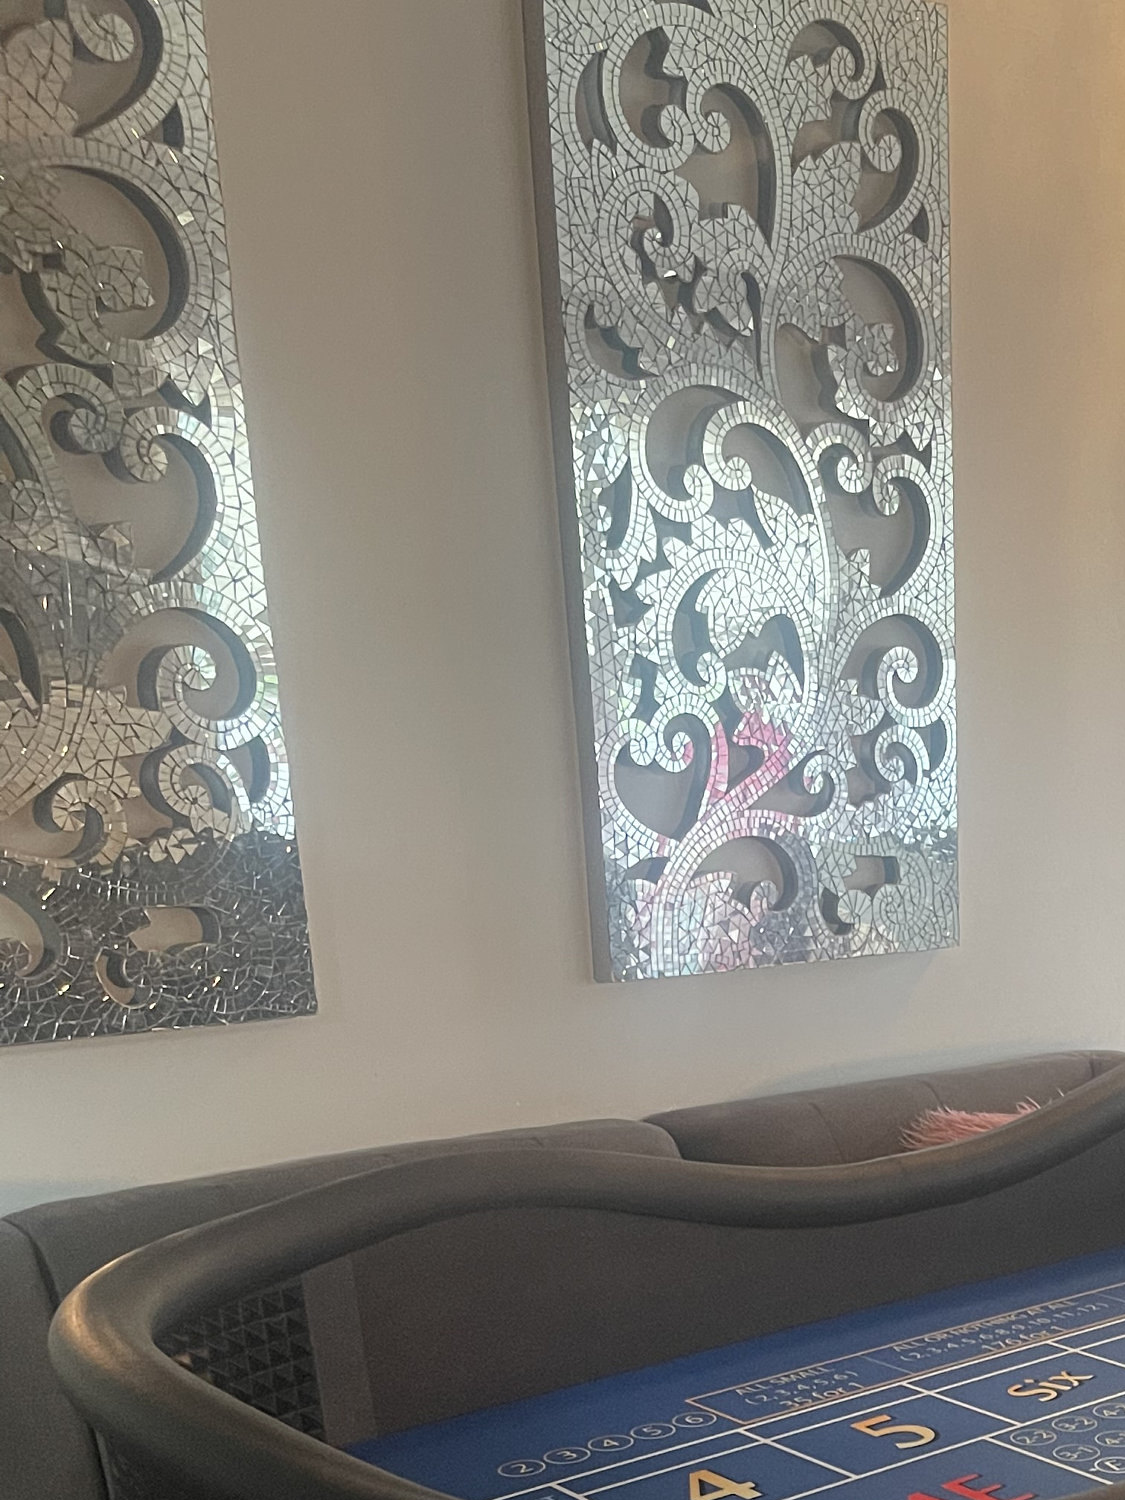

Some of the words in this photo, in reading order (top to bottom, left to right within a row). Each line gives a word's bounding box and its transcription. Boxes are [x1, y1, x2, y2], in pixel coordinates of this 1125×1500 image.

[735, 1382, 773, 1396] ALL
[769, 1366, 834, 1385] SMALL
[1007, 1370, 1095, 1402] Six
[779, 1396, 813, 1409] 35
[811, 1387, 848, 1401] for
[849, 1414, 937, 1450] 5
[1017, 1429, 1053, 1445] 2-2
[1058, 1416, 1094, 1431] 3-2
